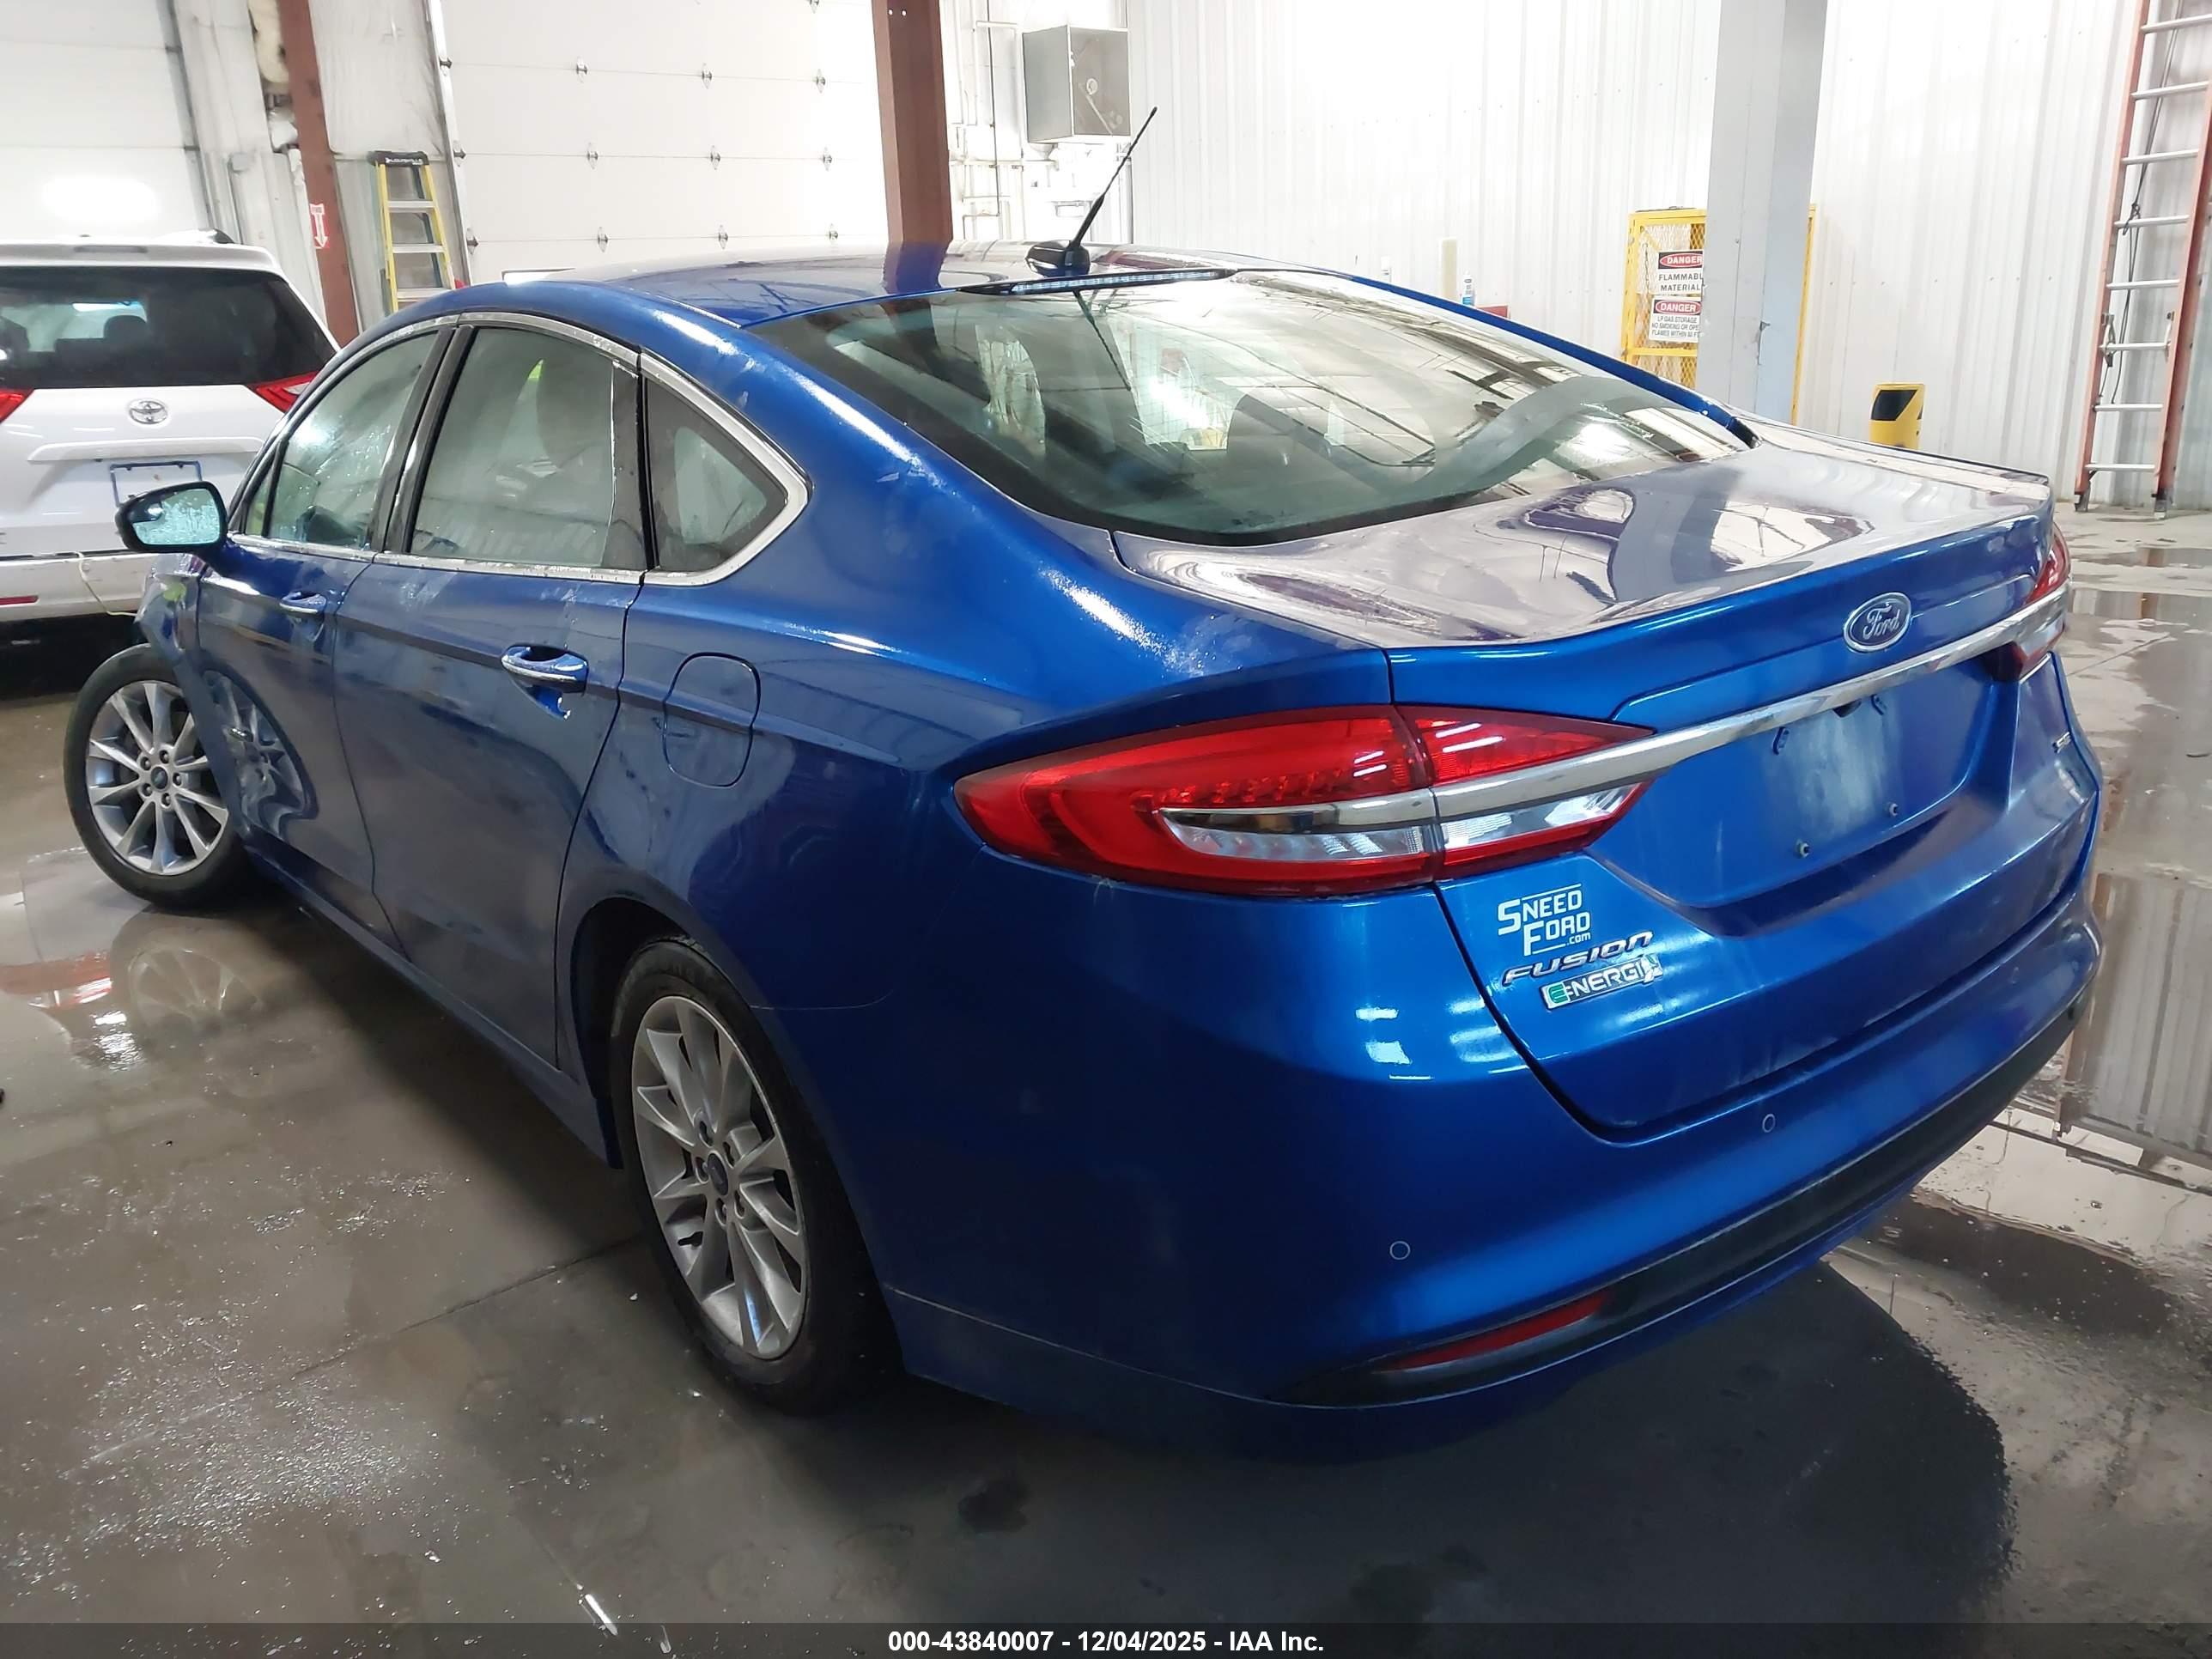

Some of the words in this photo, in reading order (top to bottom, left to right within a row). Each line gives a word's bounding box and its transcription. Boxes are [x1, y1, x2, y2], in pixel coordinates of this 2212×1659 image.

[1667, 256, 1703, 264] DANGER
[1660, 303, 1697, 313] DANGER
[1862, 602, 1901, 641] Ford
[1498, 889, 1583, 936] SNEED
[1523, 911, 1591, 957] FORD
[1566, 932, 1591, 945] .com
[1503, 931, 1654, 986] FUSION
[1548, 960, 1645, 1004] ENERGI
